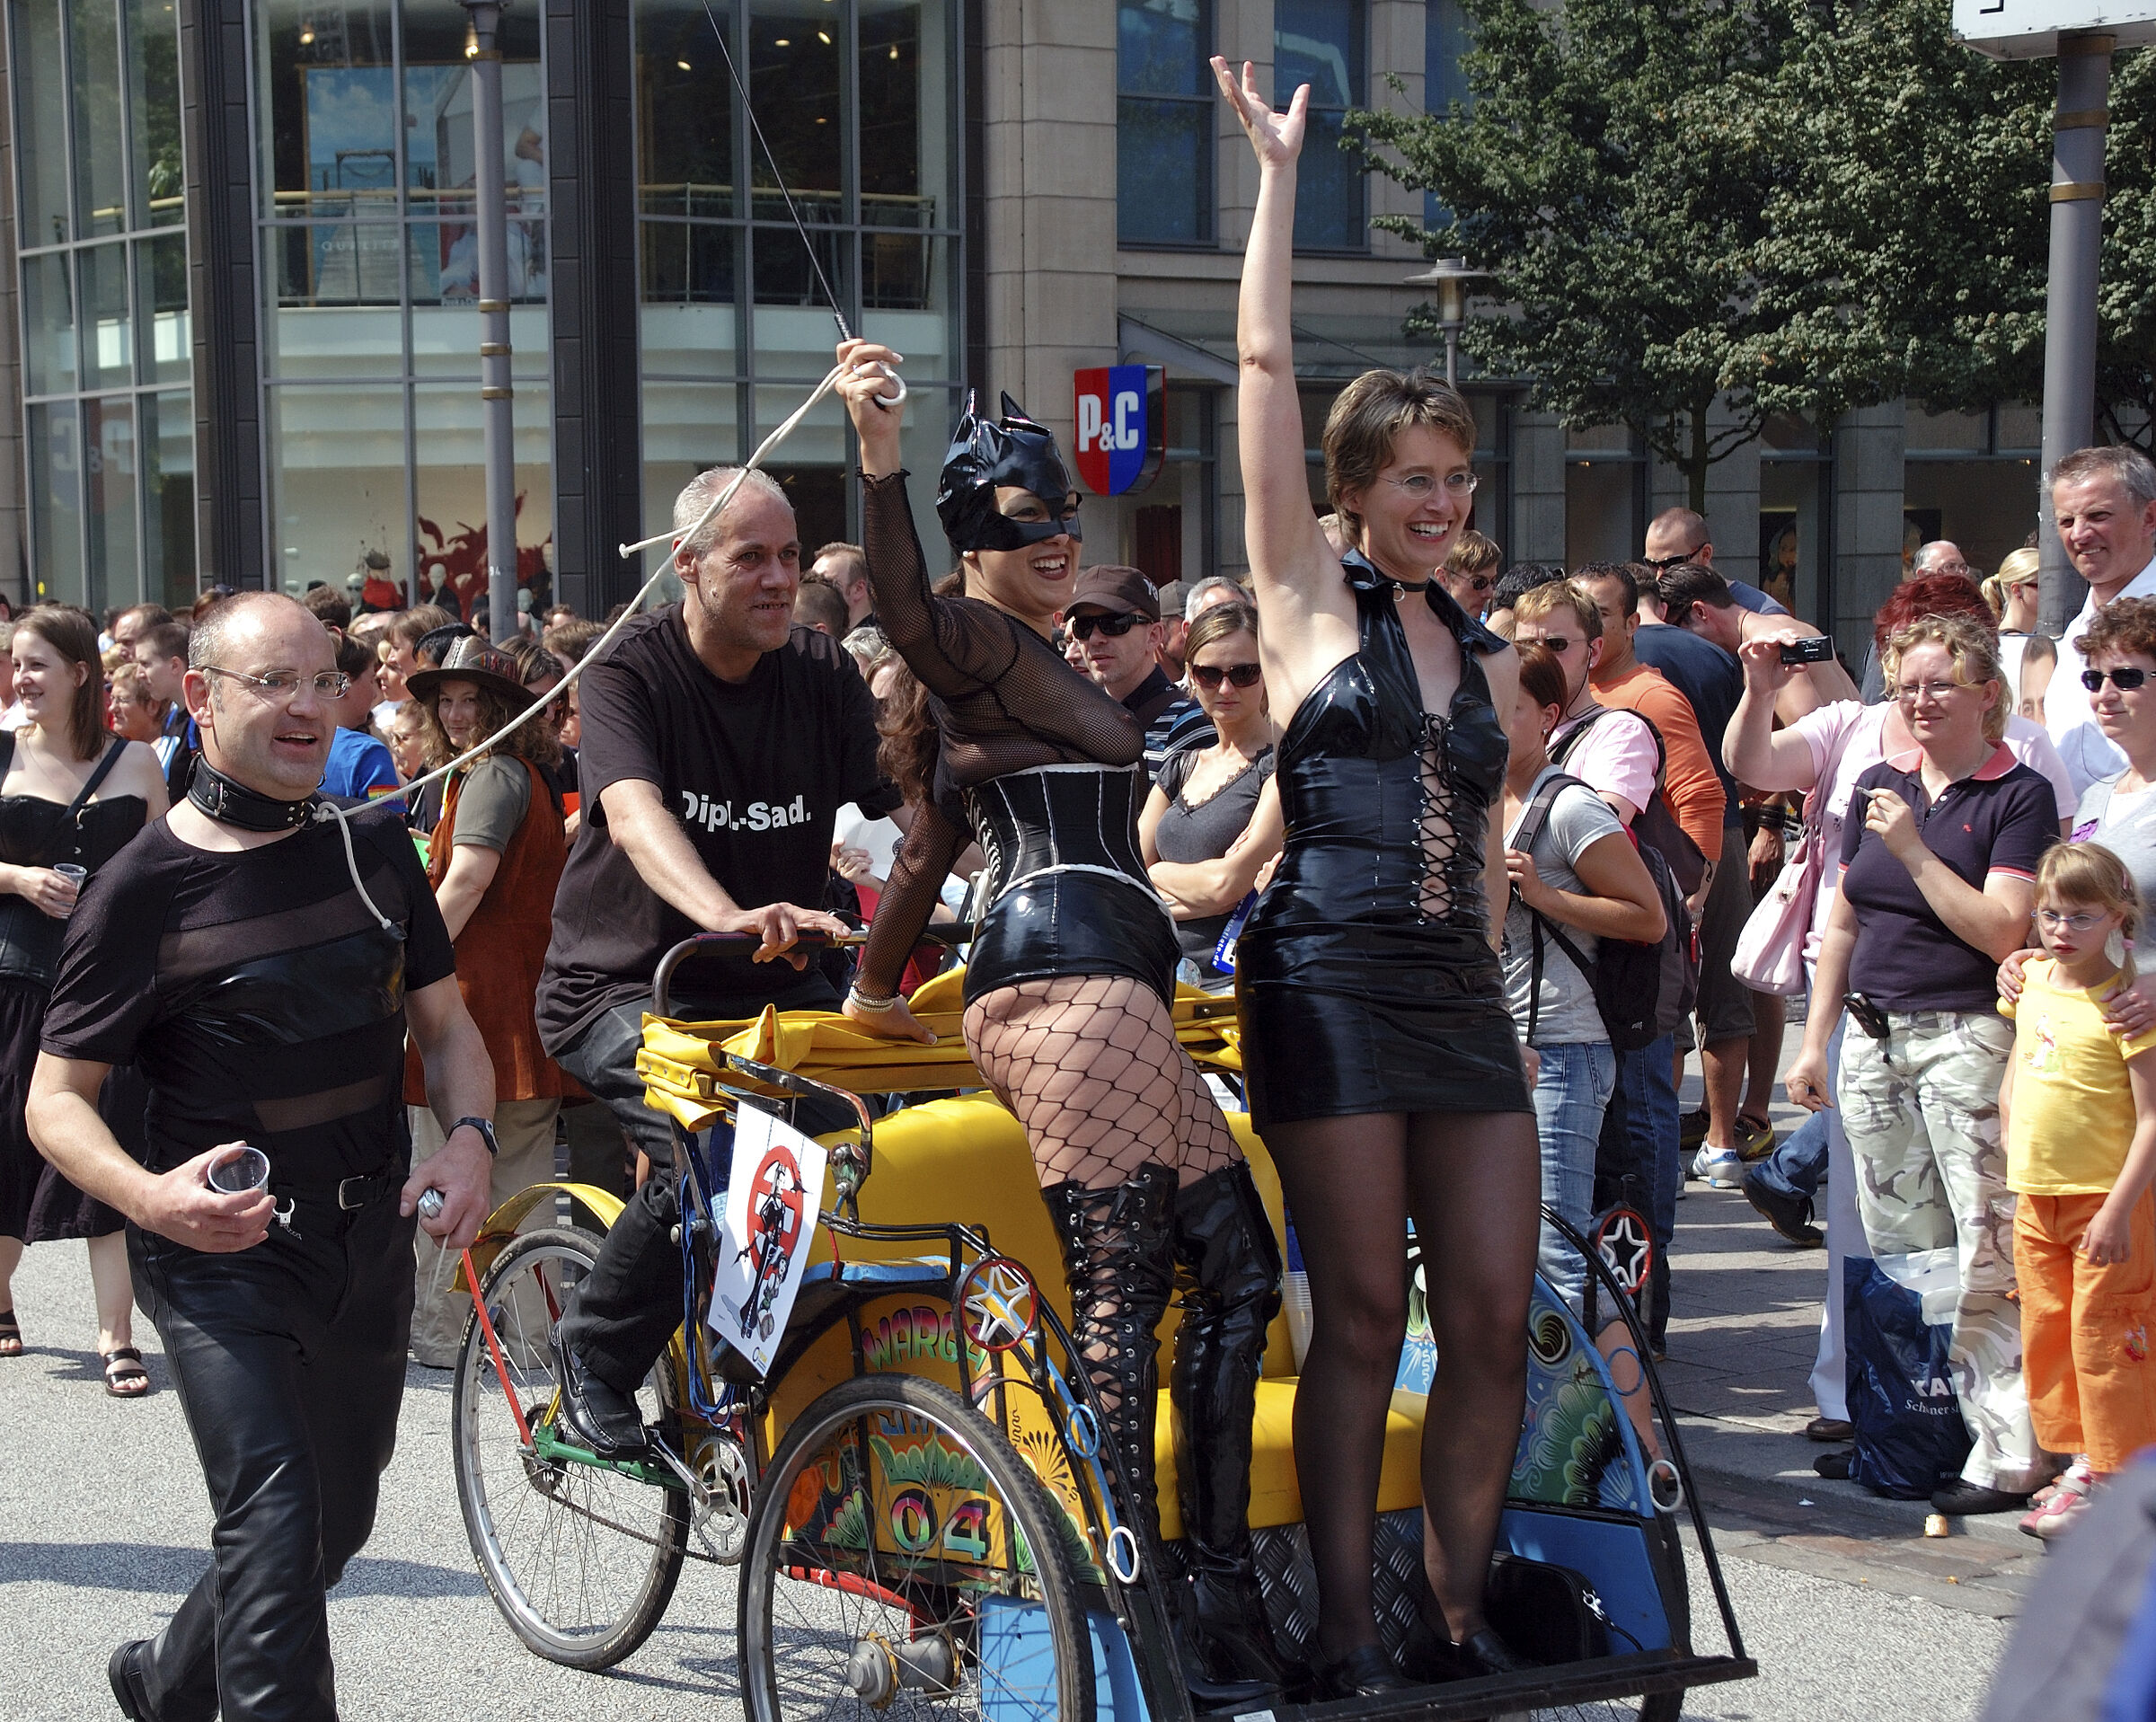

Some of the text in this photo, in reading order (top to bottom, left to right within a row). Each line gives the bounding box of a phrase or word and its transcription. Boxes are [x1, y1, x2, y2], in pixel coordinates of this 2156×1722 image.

[1078, 391, 1139, 453] P&C
[1904, 1399, 1950, 1416] Schner
[890, 1488, 992, 1561] 04
